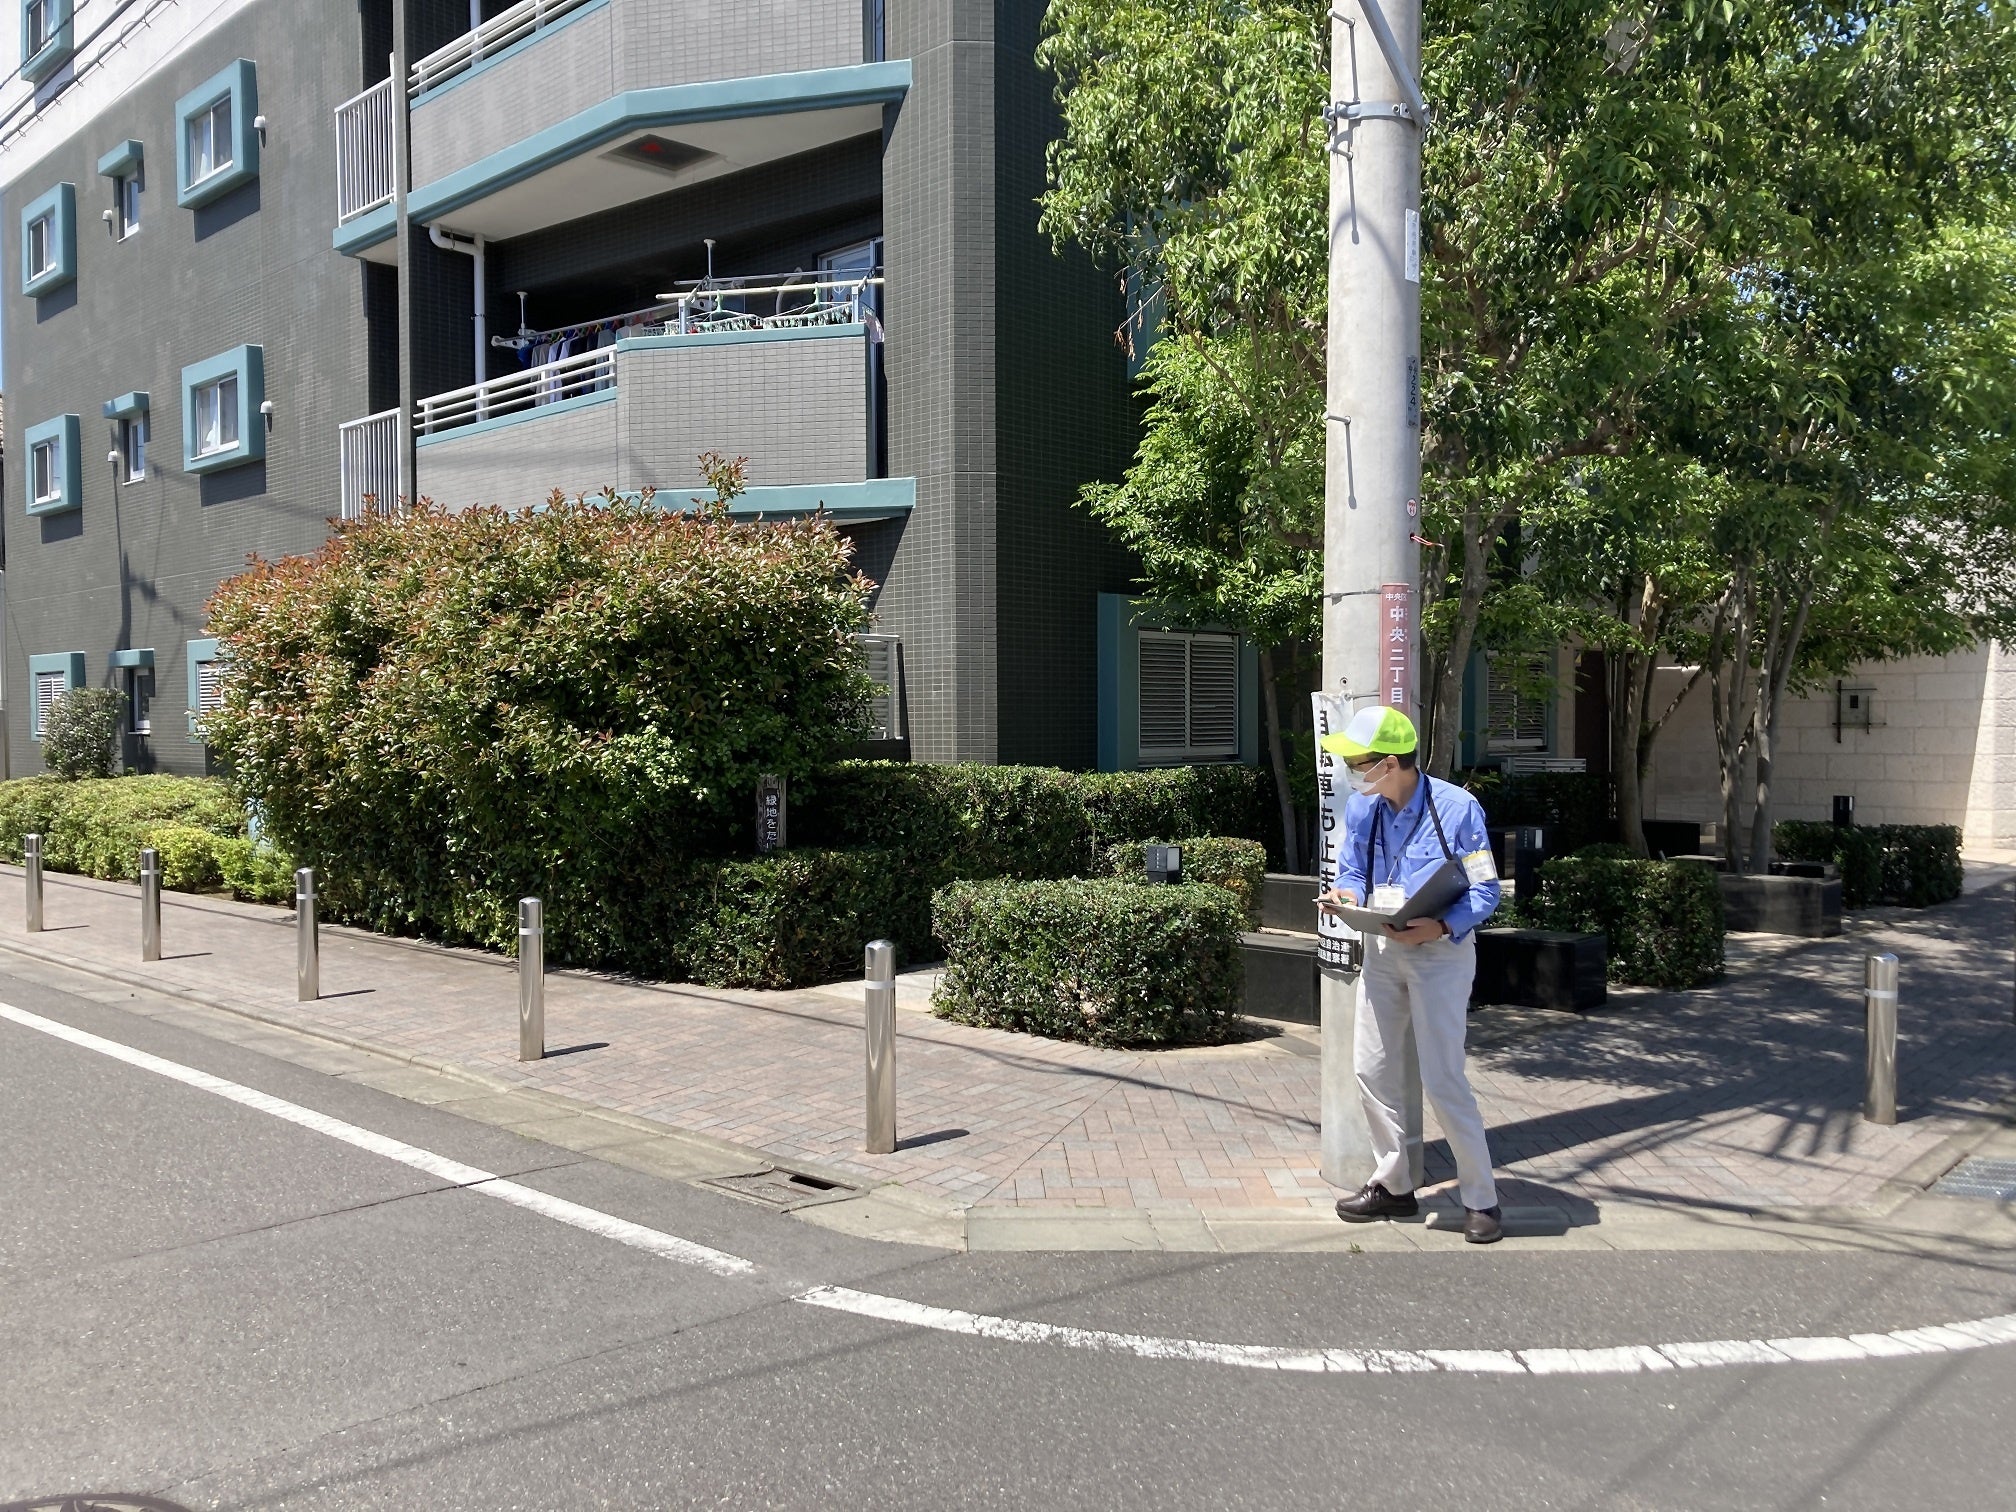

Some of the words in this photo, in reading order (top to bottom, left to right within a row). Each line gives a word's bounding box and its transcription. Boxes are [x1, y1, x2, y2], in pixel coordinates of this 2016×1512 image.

[1385, 592, 1407, 601] 中央区
[1390, 605, 1405, 704] 中央二丁目
